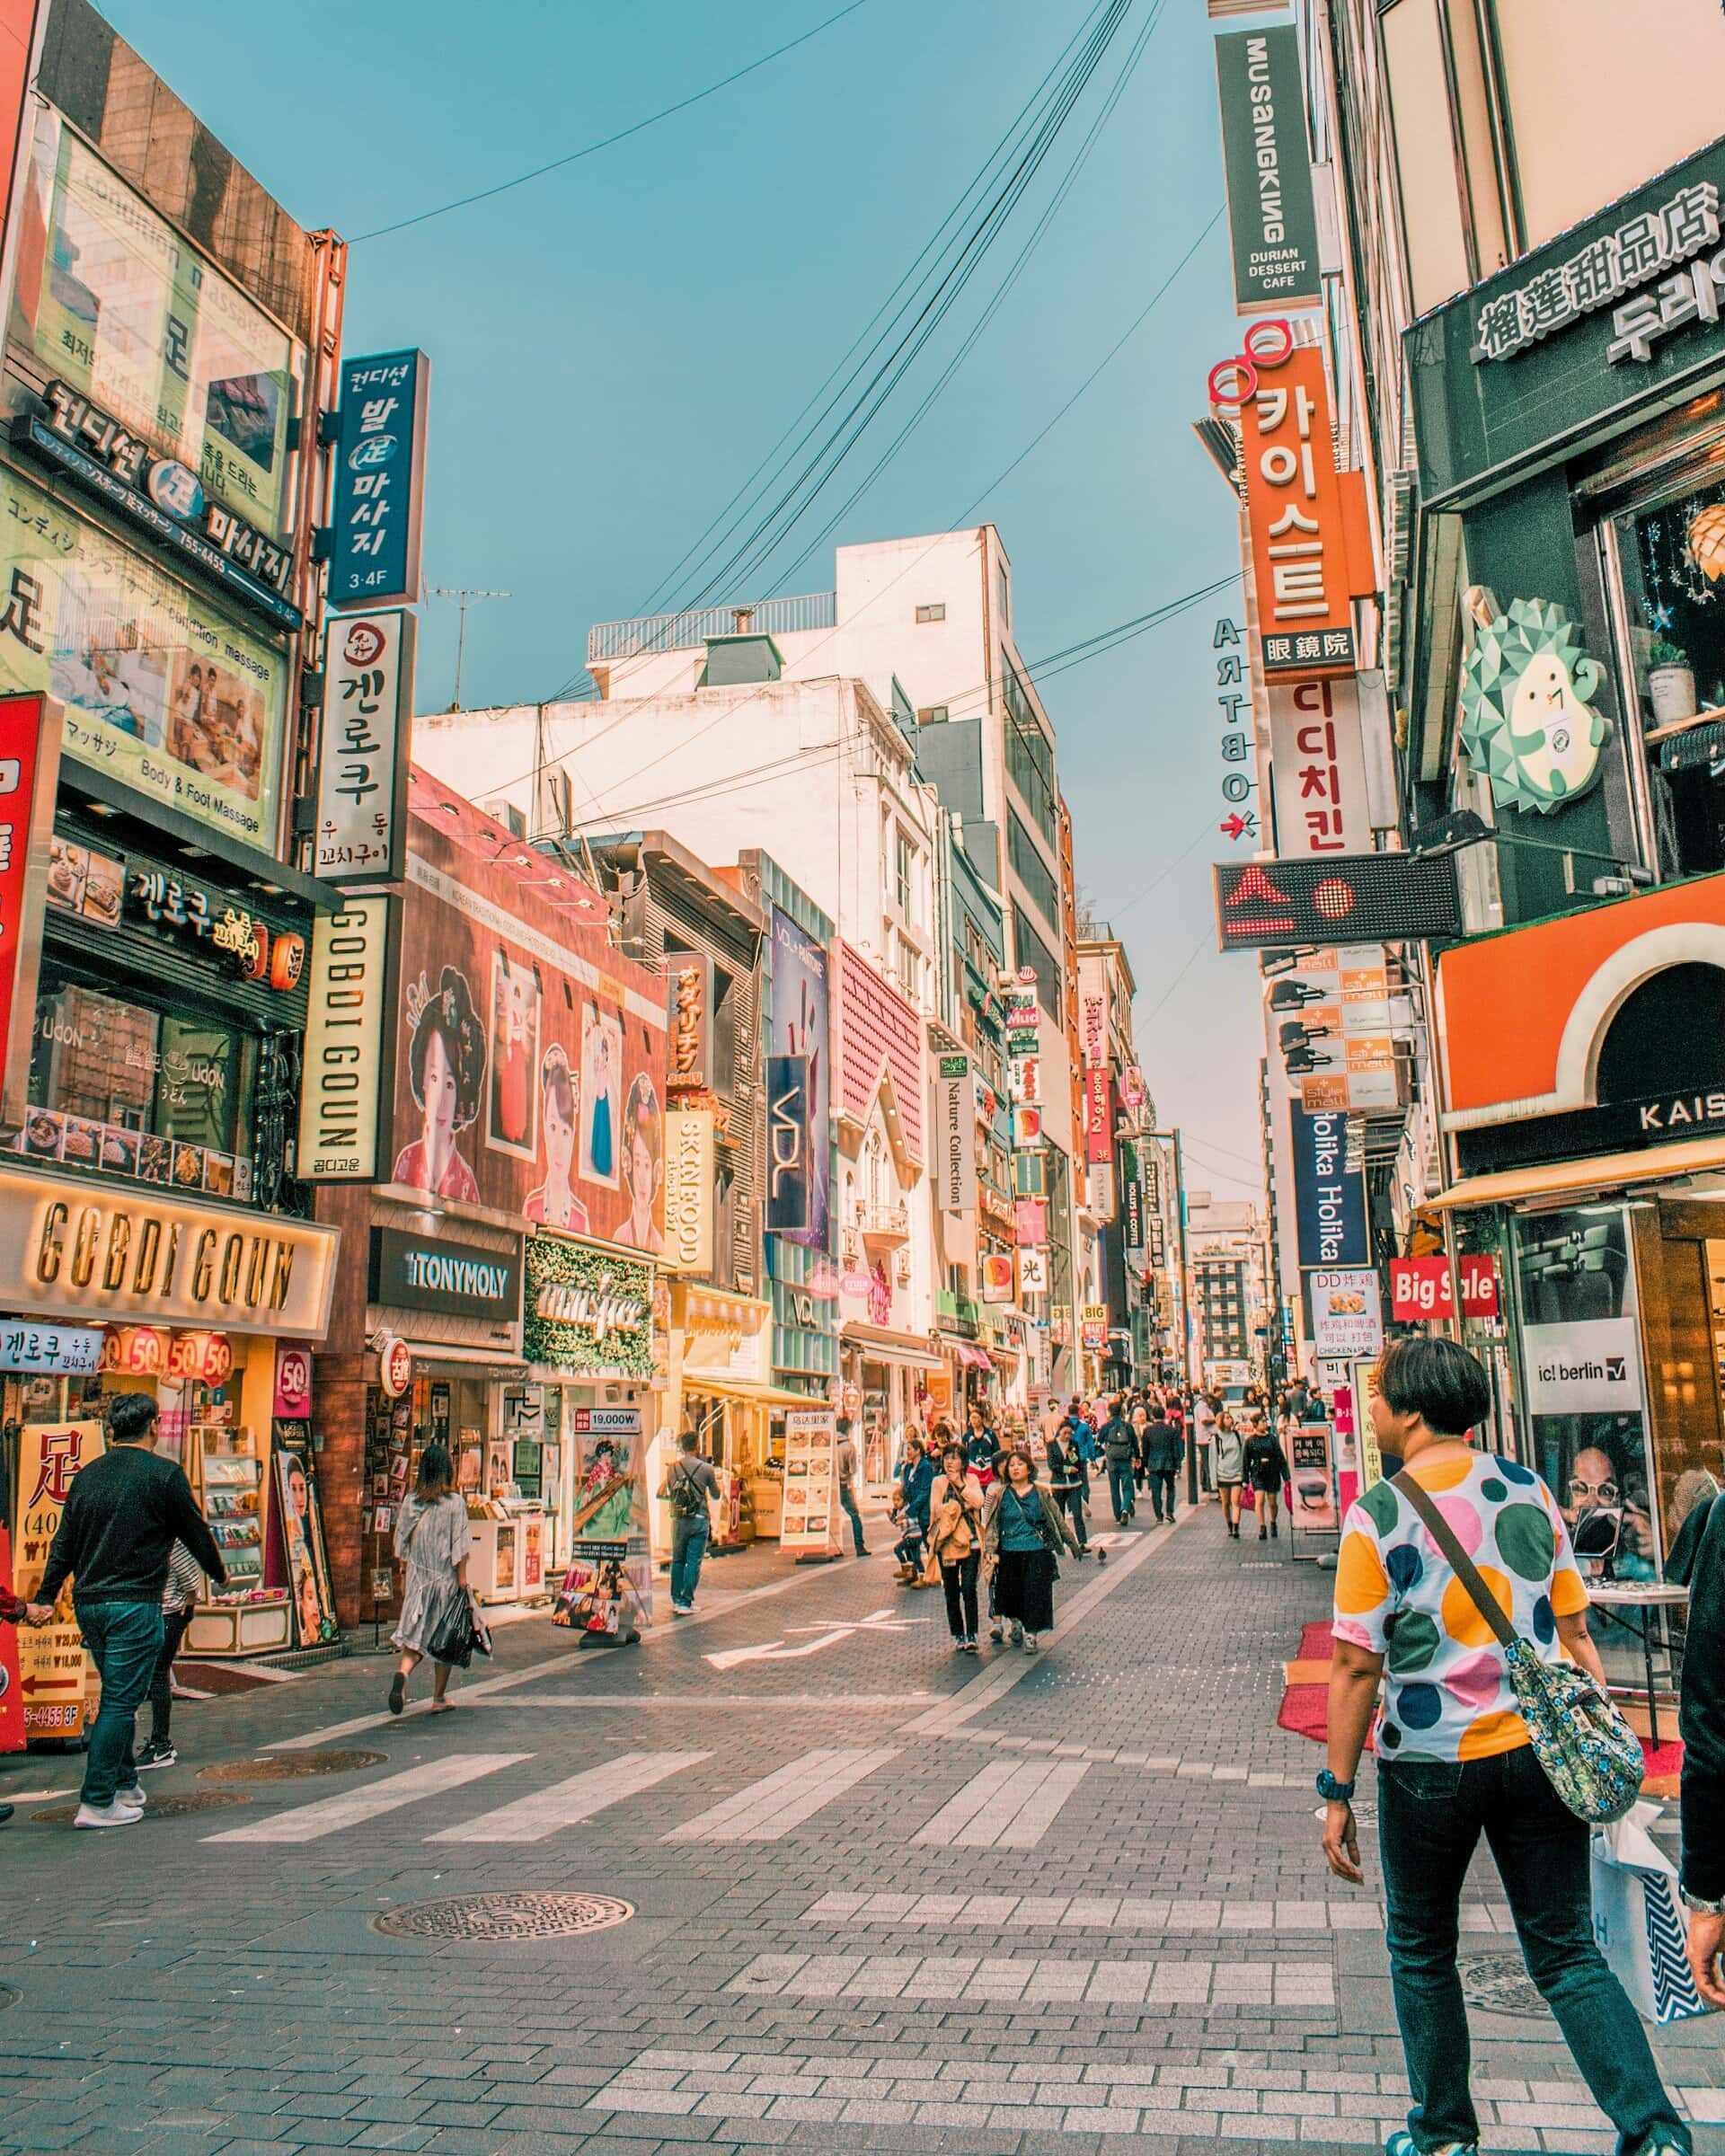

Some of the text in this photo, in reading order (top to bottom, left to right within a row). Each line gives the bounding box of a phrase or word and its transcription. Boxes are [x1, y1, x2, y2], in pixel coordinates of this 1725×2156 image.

[1249, 261, 1306, 278] DESSERT
[1251, 248, 1298, 263] DURIAN
[1262, 275, 1295, 289] CAFE
[350, 364, 409, 393] 컨디션
[49, 381, 148, 482] 컨디션
[208, 504, 295, 591] 마사지
[1256, 384, 1329, 620] 카이스트
[180, 529, 226, 573] 755-4455
[225, 642, 270, 681] massage
[1265, 632, 1349, 663] 眼鏡院
[335, 669, 385, 805] 겐로쿠
[1294, 680, 1345, 852] 디디치킨
[140, 758, 261, 835] Body & Foot Massage
[319, 844, 389, 866] 꼬치구이
[137, 872, 212, 937] 겐로쿠
[318, 909, 367, 1149] GOBDI GOUN
[948, 1081, 961, 1131] Nature
[771, 1084, 801, 1199] VDL
[314, 1158, 360, 1172] 곱디고운
[949, 1135, 963, 1204] Collection
[679, 1122, 702, 1264] SKINFOOD
[1317, 1185, 1345, 1261] Holika
[36, 1202, 296, 1311] GOBDI GOUN
[416, 1251, 509, 1299] TONYMOLY
[1022, 1259, 1042, 1283] 光
[791, 1292, 818, 1327] VDL
[1395, 1268, 1494, 1311] Big Sale
[1084, 1307, 1105, 1320] BIG
[6, 1330, 60, 1366] 겐로쿠
[1538, 1361, 1604, 1383] ic! berlin
[29, 1429, 84, 1509] 足
[64, 1706, 78, 1727] 3F
